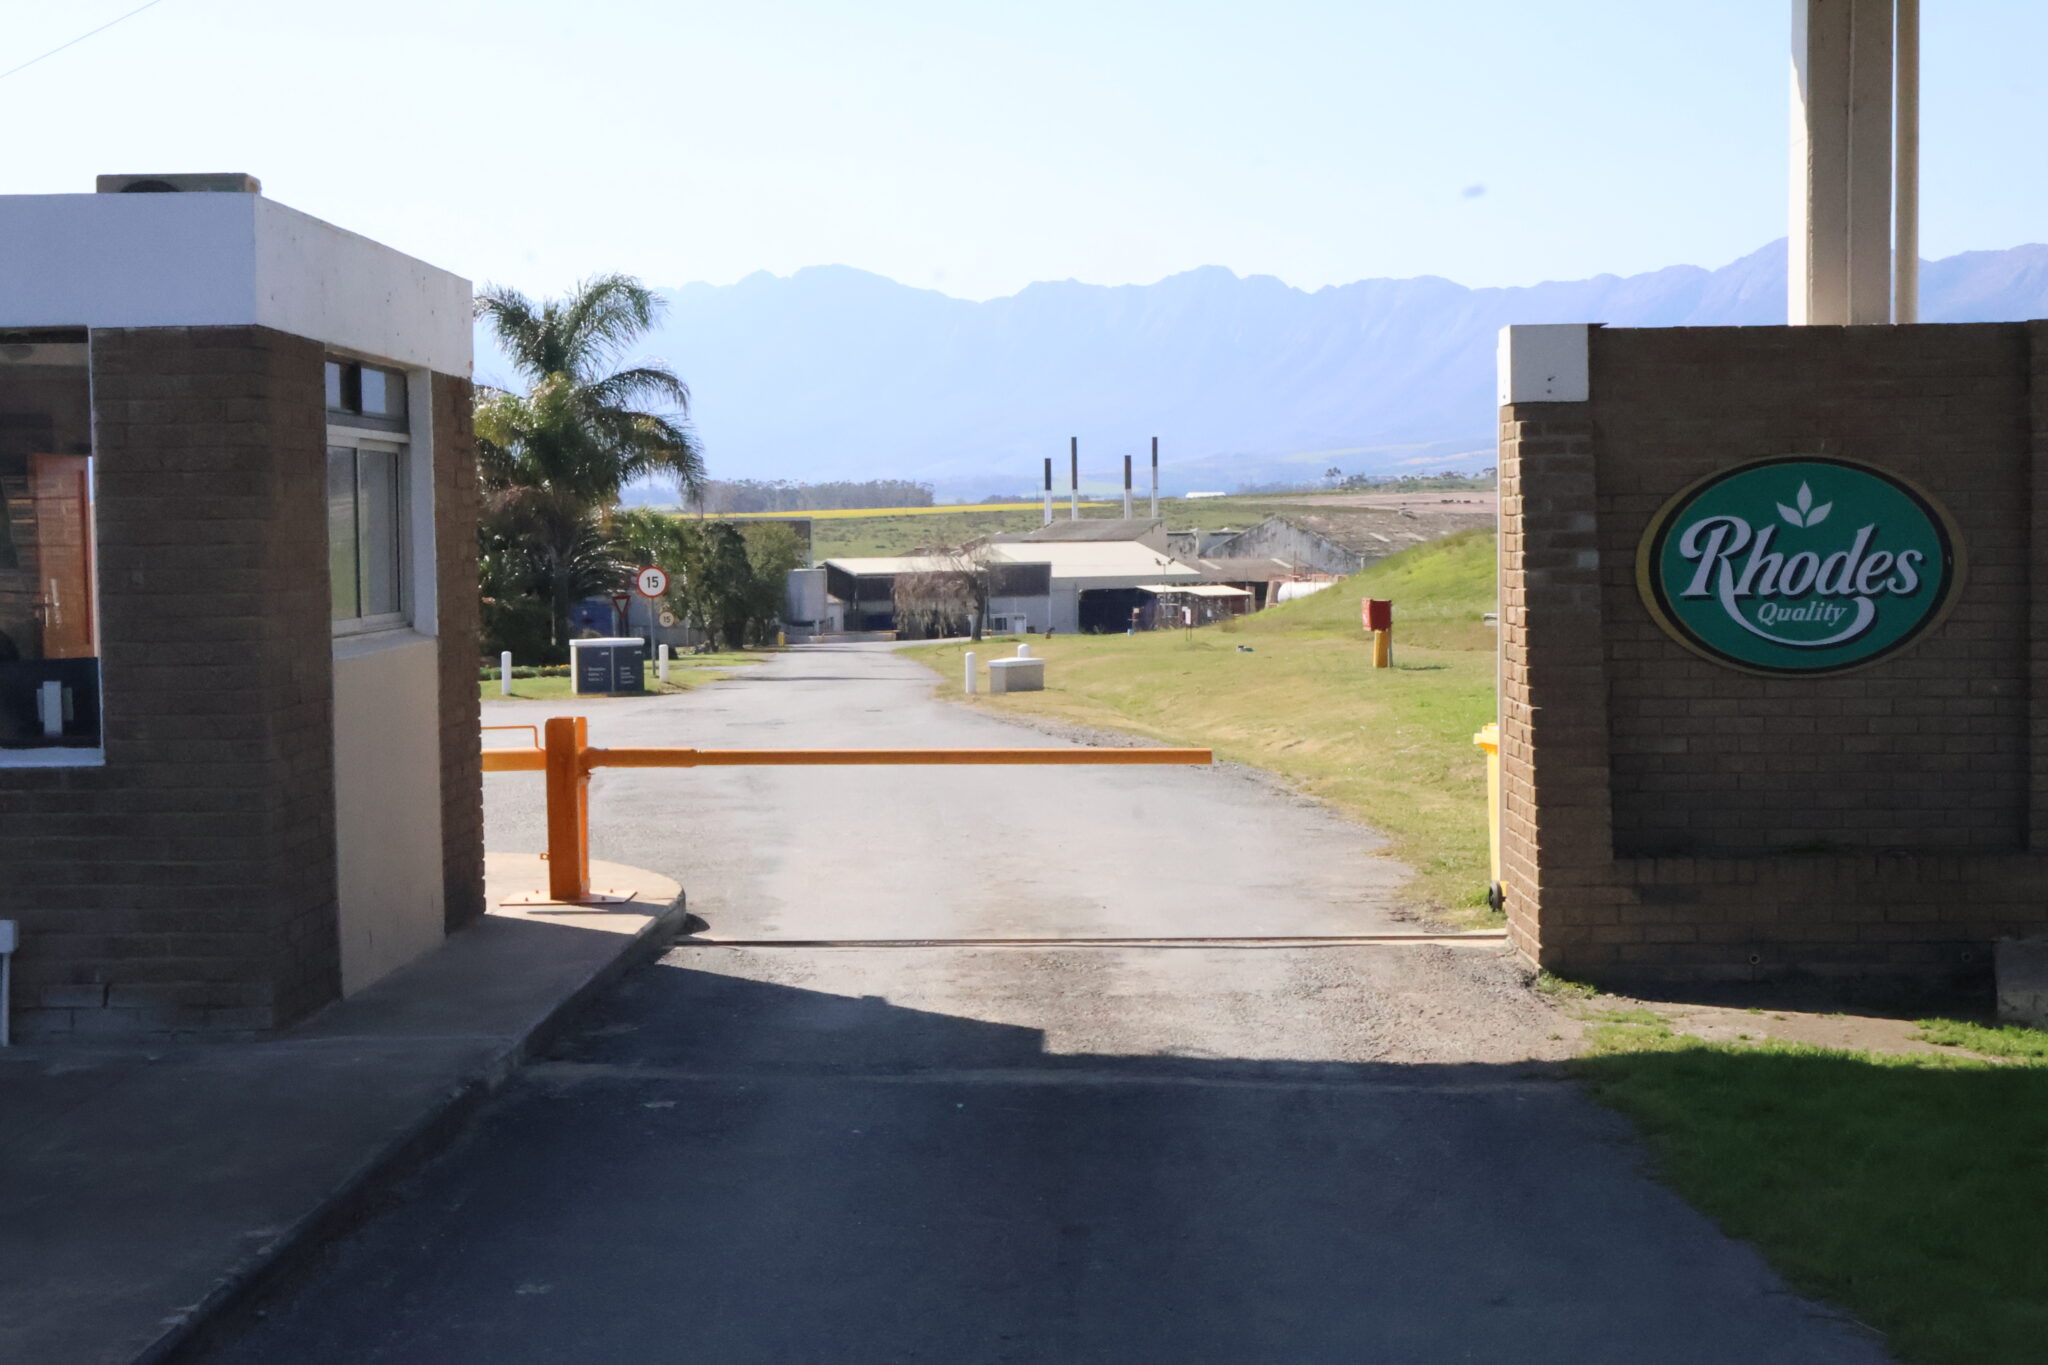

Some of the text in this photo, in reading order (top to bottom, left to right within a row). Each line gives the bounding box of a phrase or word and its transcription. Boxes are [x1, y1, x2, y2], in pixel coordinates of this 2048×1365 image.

[646, 576, 659, 588] 15
[1679, 515, 1923, 646] Rhodes
[1757, 601, 1848, 626] Quality
